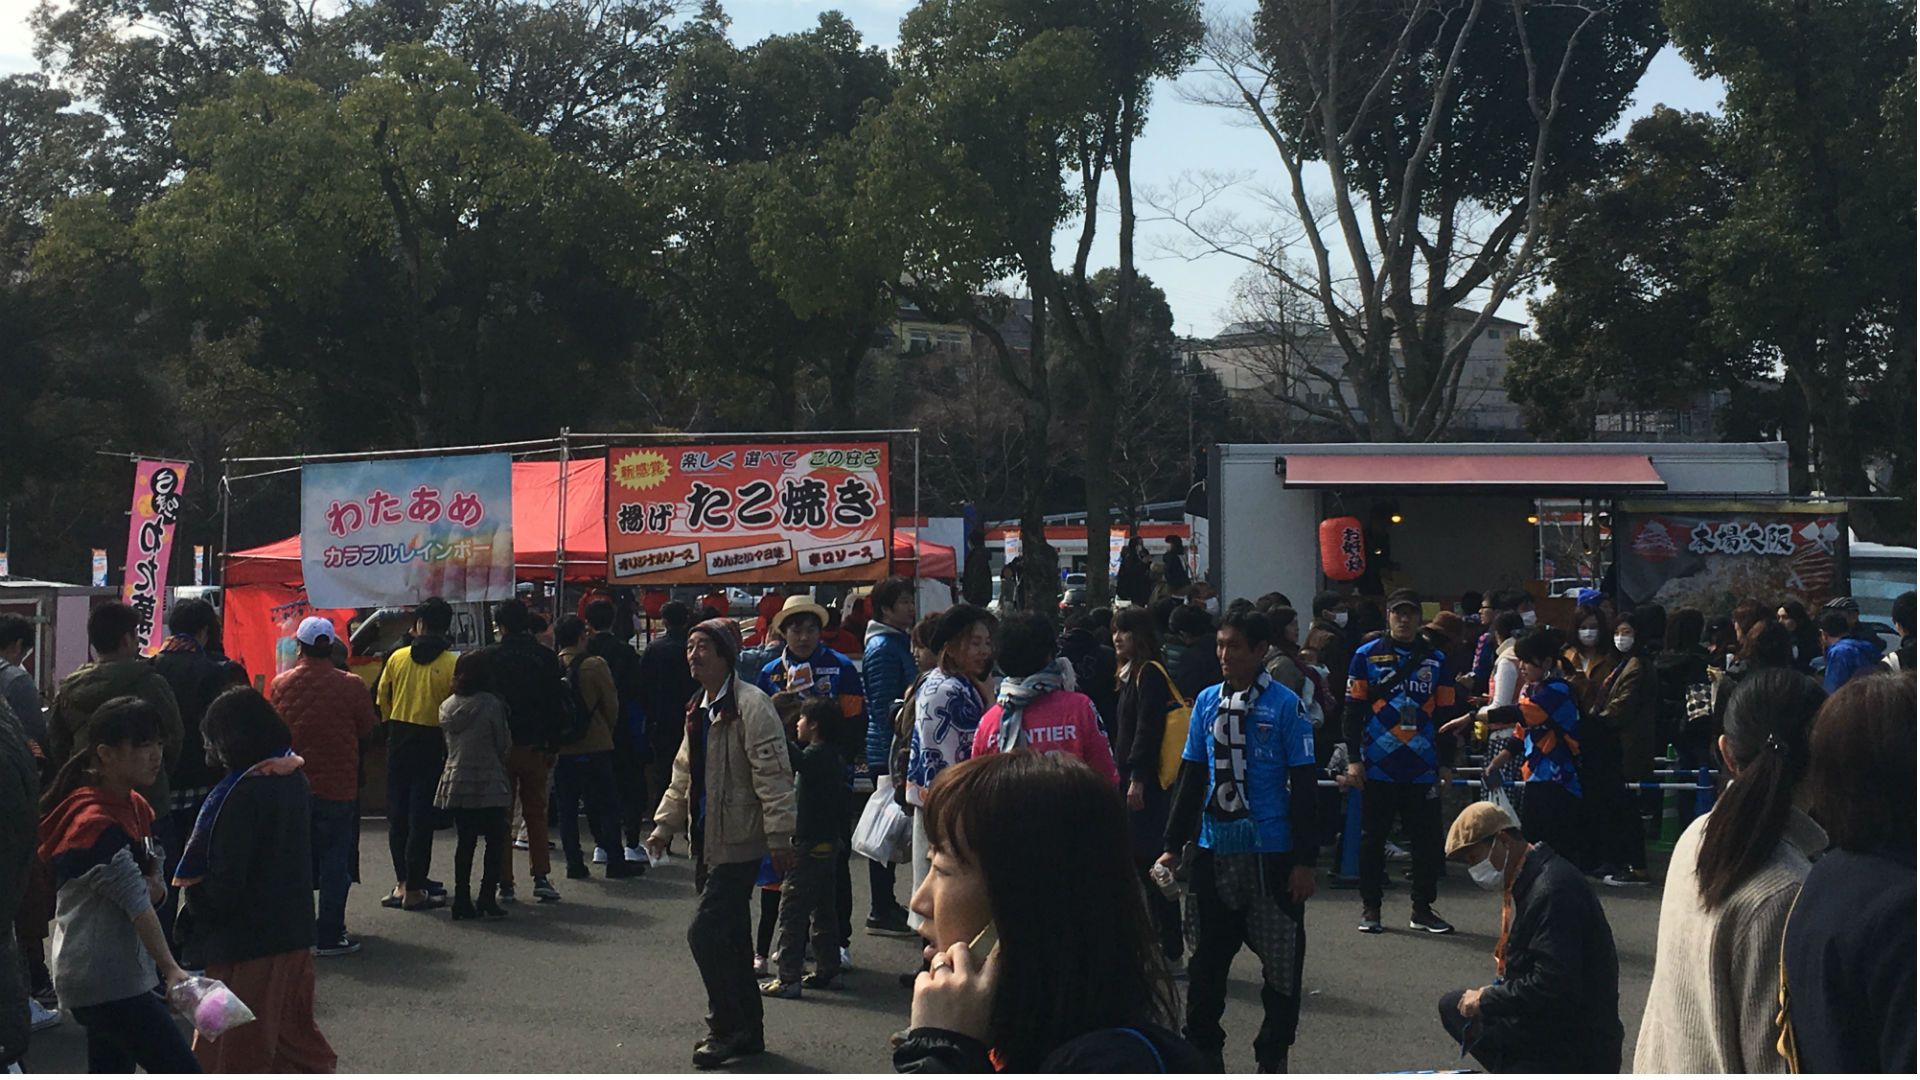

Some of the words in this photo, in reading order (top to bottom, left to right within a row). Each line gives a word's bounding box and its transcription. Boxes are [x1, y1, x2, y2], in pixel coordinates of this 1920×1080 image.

[681, 452, 735, 469] 楽しく
[744, 451, 796, 467] 選べて
[810, 450, 879, 467] この安さ
[327, 486, 483, 536] わたあめ
[1690, 522, 1794, 554] 本場大阪
[324, 541, 491, 568] カラフルレインボー
[618, 548, 695, 570] オリジナルソース
[809, 545, 872, 566] 辛口ソース
[987, 725, 1076, 748] FNTIER
